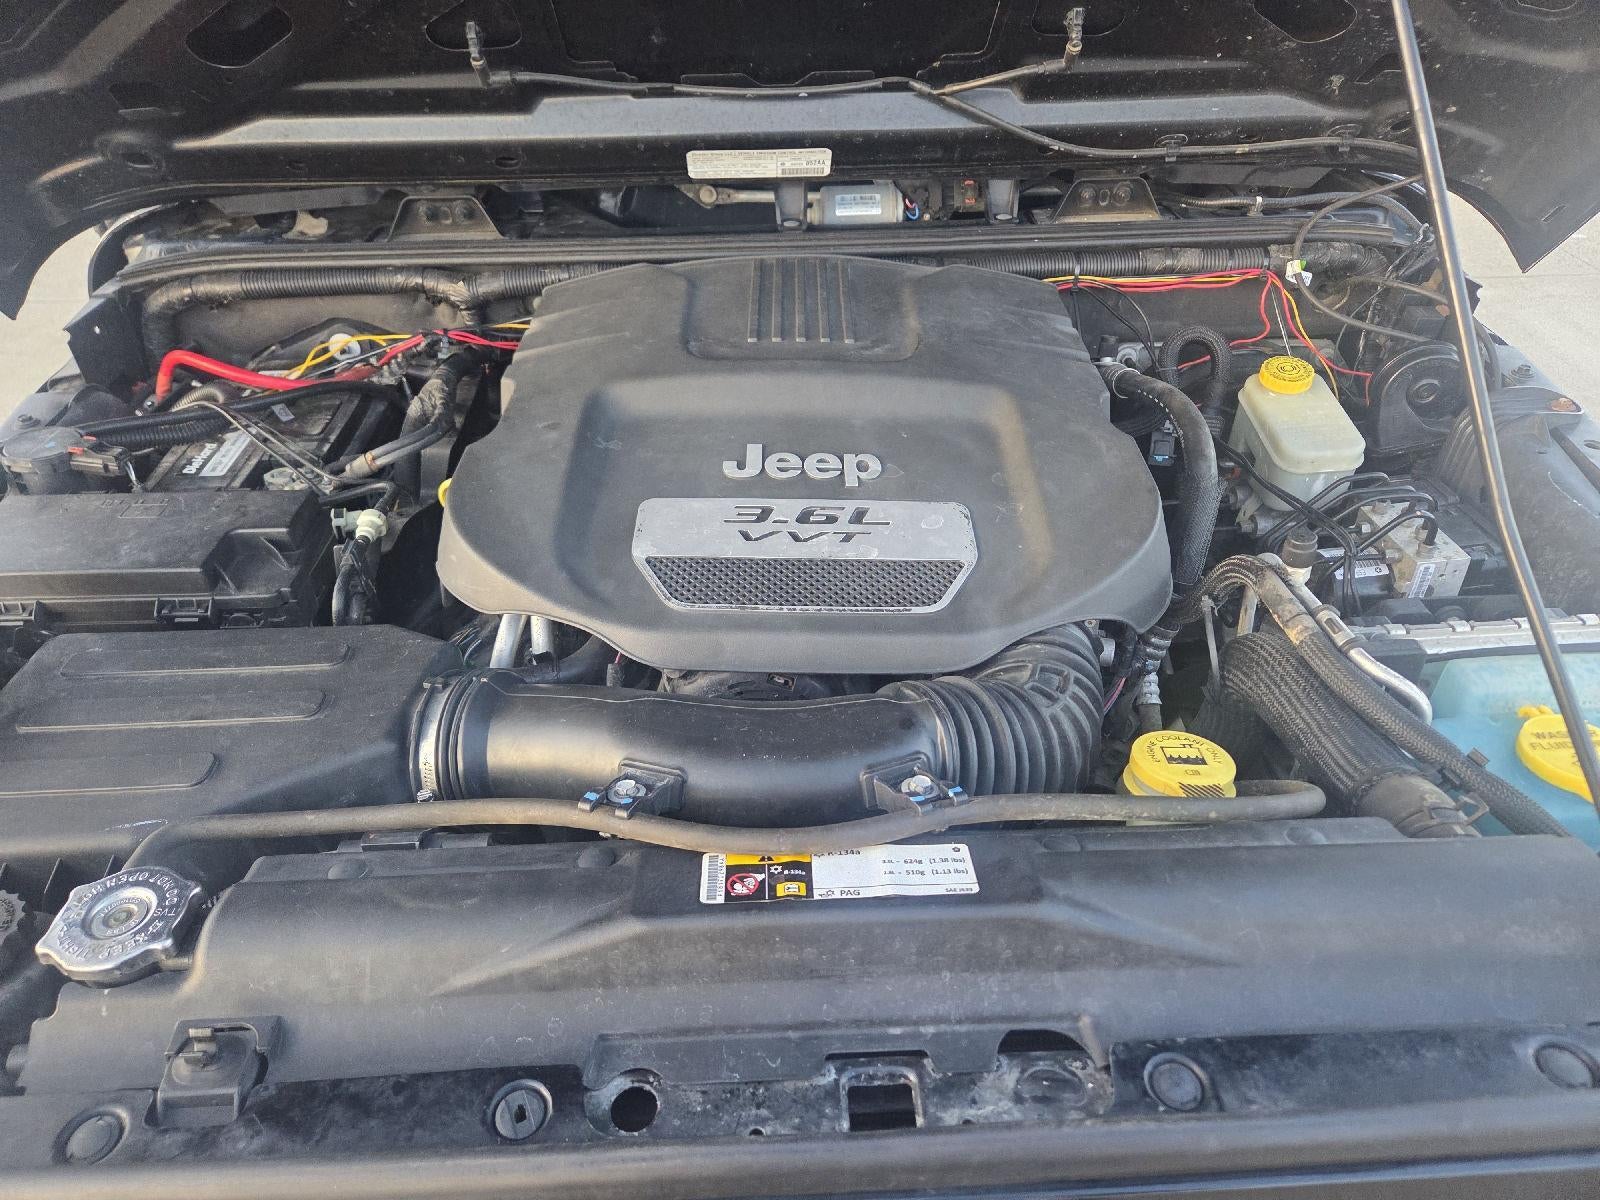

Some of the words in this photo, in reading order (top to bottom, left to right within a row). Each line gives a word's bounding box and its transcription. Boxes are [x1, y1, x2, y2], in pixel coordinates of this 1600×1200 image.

[182, 443, 217, 474] DieHard
[722, 443, 882, 487] Jeep
[723, 505, 892, 526] 3.6L
[738, 529, 872, 543] VVT
[1531, 730, 1598, 739] WASR
[1146, 740, 1161, 763] ENGINE
[1156, 735, 1205, 747] COOLANT
[1205, 747, 1223, 765] ONLY
[106, 871, 149, 888] OPEN
